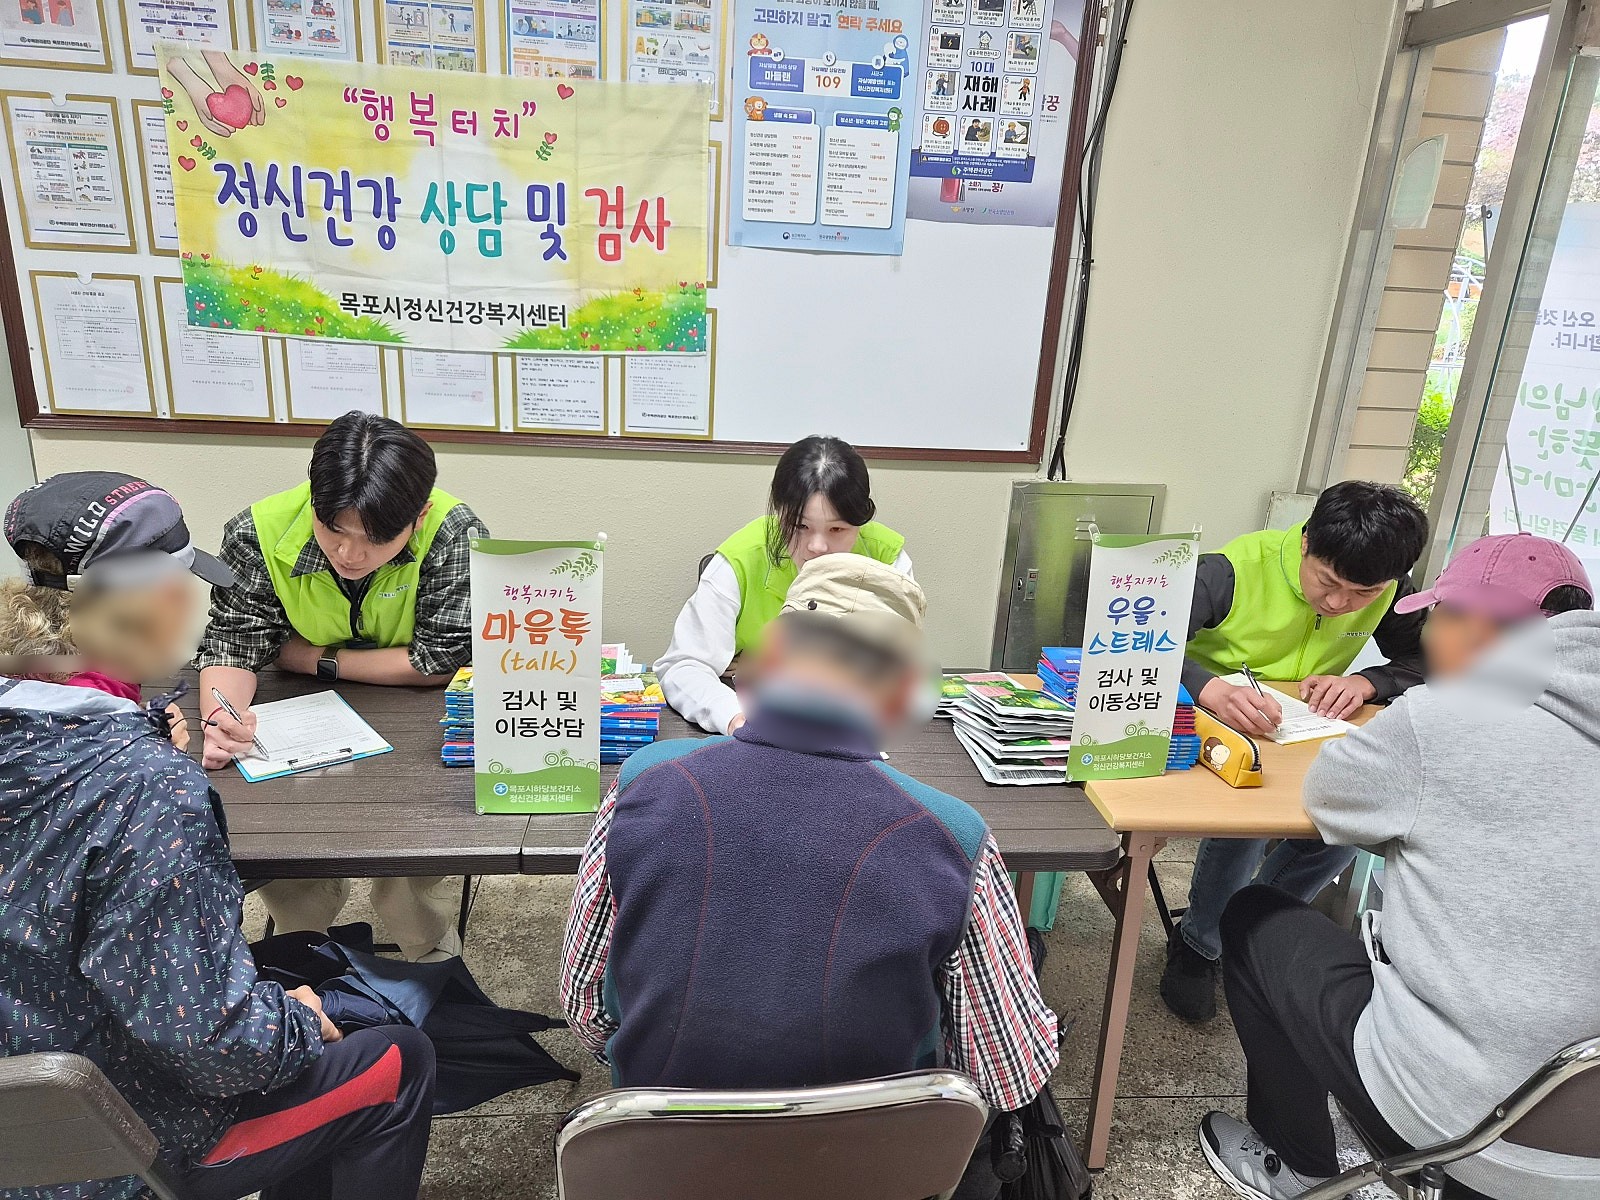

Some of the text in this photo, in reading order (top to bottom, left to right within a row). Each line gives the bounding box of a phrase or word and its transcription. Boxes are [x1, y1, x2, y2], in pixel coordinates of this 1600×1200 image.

[753, 8, 903, 33] 고민하지 말고 연락 주세요
[931, 27, 939, 35] 10
[970, 61, 995, 74] 10대
[815, 75, 841, 89] 109
[963, 74, 999, 93] 재해
[961, 94, 997, 113] 사례
[213, 161, 402, 251] 정신건강
[420, 180, 508, 258] 상담
[526, 181, 567, 261] 및
[584, 185, 672, 262] 검사
[339, 292, 567, 328] 목포시정신건강복지센터
[63, 500, 107, 553] WILD
[1110, 574, 1169, 592] 행복지키는
[503, 584, 577, 605] 행복지키는
[481, 607, 592, 647] 마음톡
[1087, 629, 1178, 656] 스트레스
[500, 648, 577, 674] (talk)
[1097, 667, 1159, 688] 검사 및
[501, 689, 577, 711] 검사 및
[1089, 692, 1162, 713] 이동상담
[495, 717, 585, 738] 이동상담
[1092, 760, 1145, 771] 정신건강복지센터
[1094, 751, 1152, 762] 목포시하당보건지소
[509, 784, 582, 794] 목포시하당보건지소
[509, 793, 574, 803] 정신건강복지센터
